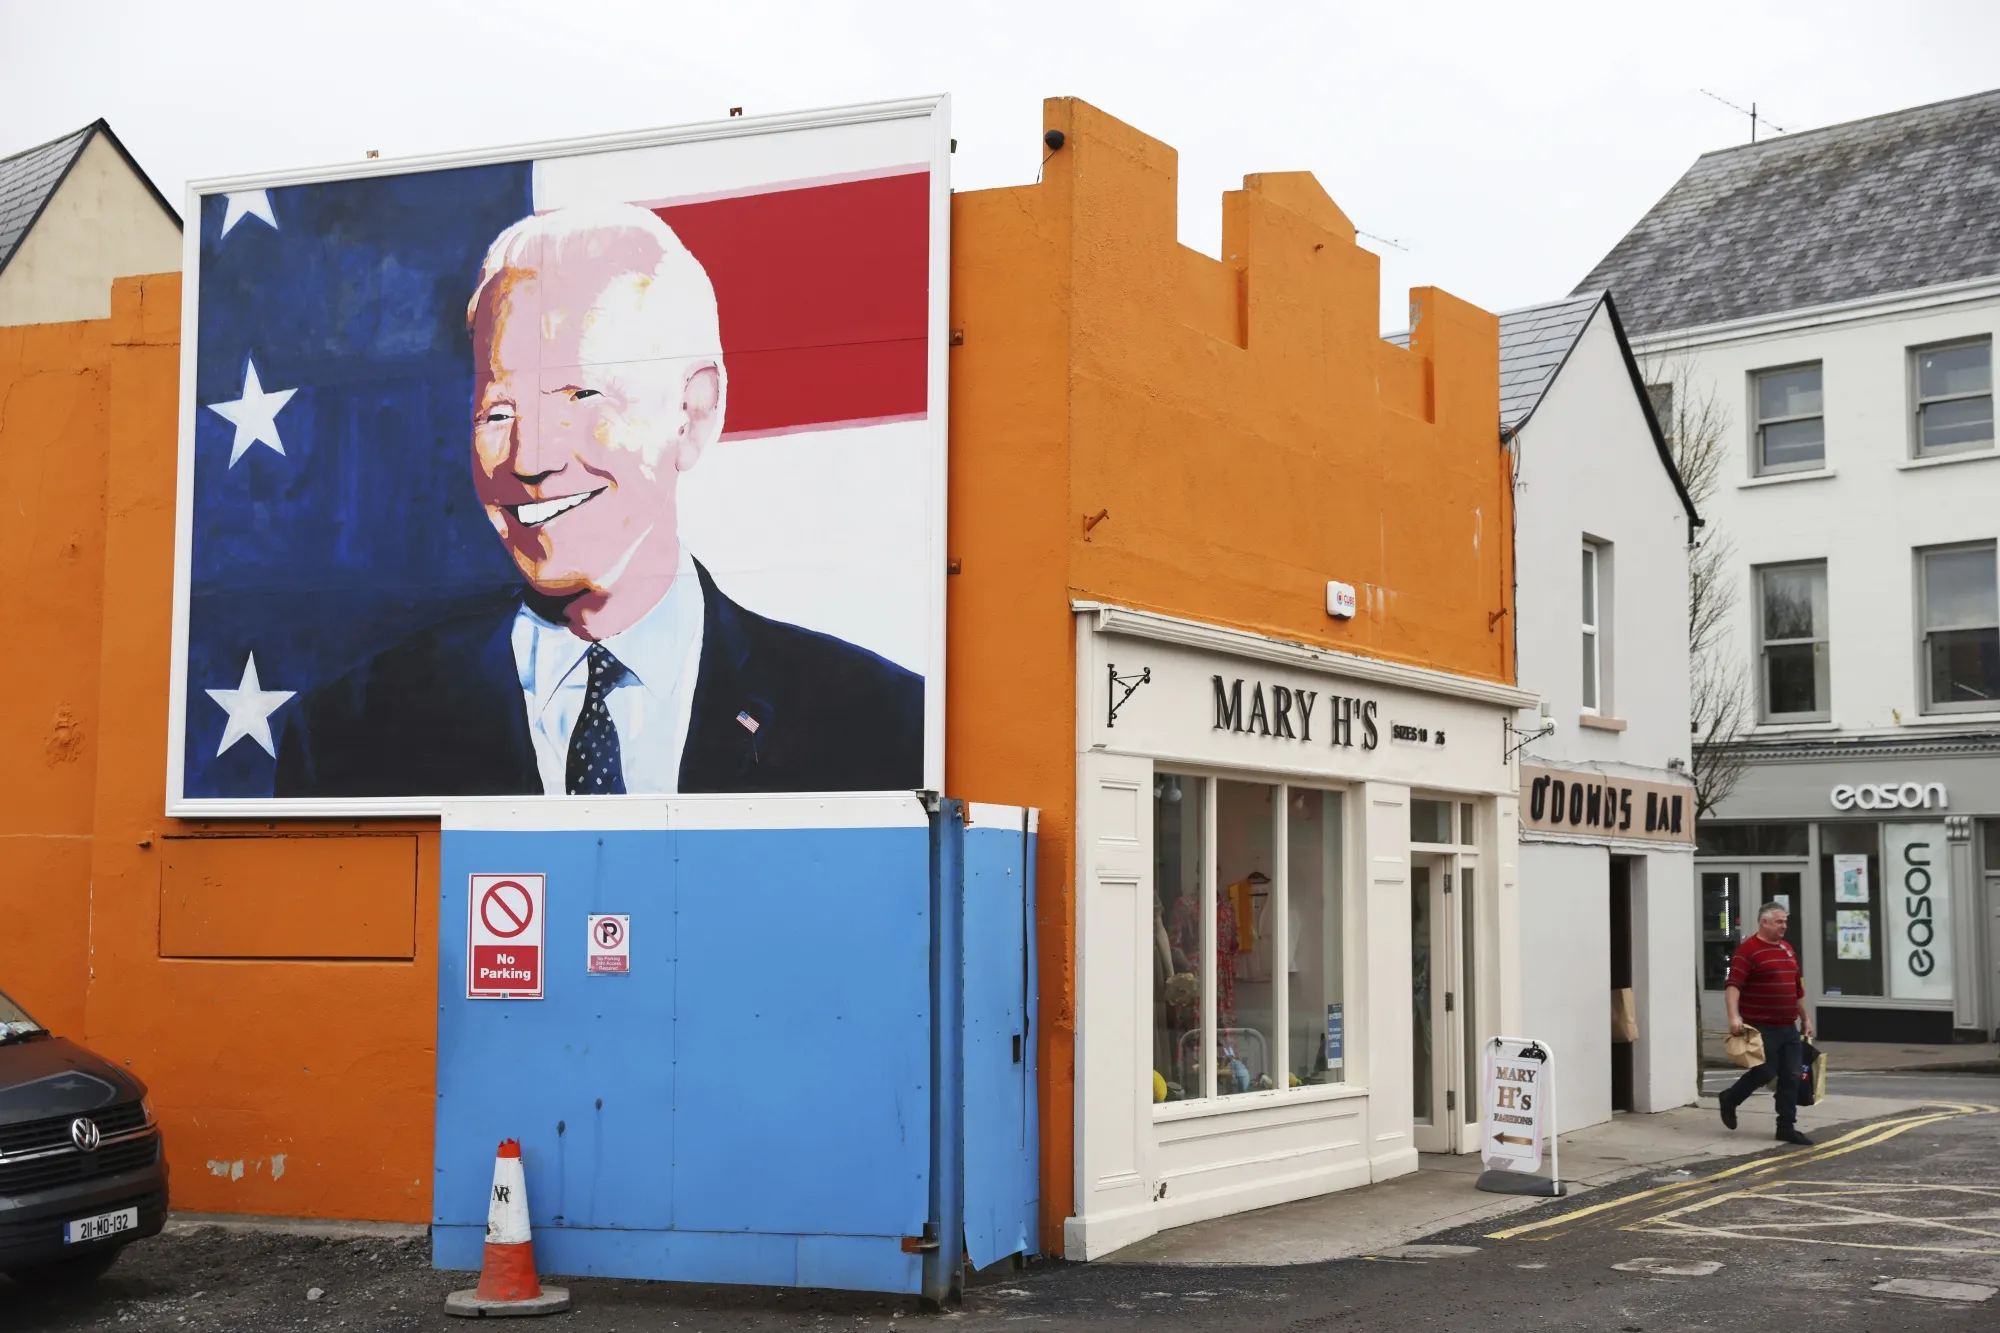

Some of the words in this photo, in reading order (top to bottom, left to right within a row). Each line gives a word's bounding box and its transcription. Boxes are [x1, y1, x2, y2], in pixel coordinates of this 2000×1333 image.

[1213, 675, 1318, 741] MARY
[1331, 695, 1379, 750] H'S
[1394, 724, 1417, 741] SIZES
[1830, 782, 1948, 810] eason
[1645, 792, 1682, 834] BAR
[1904, 842, 1935, 977] eason
[497, 954, 515, 965] No
[480, 968, 531, 980] Parking
[1496, 1066, 1536, 1083] MARY
[1494, 1113, 1533, 1125] FASHIONS
[81, 1214, 128, 1239] 211-MO-132
